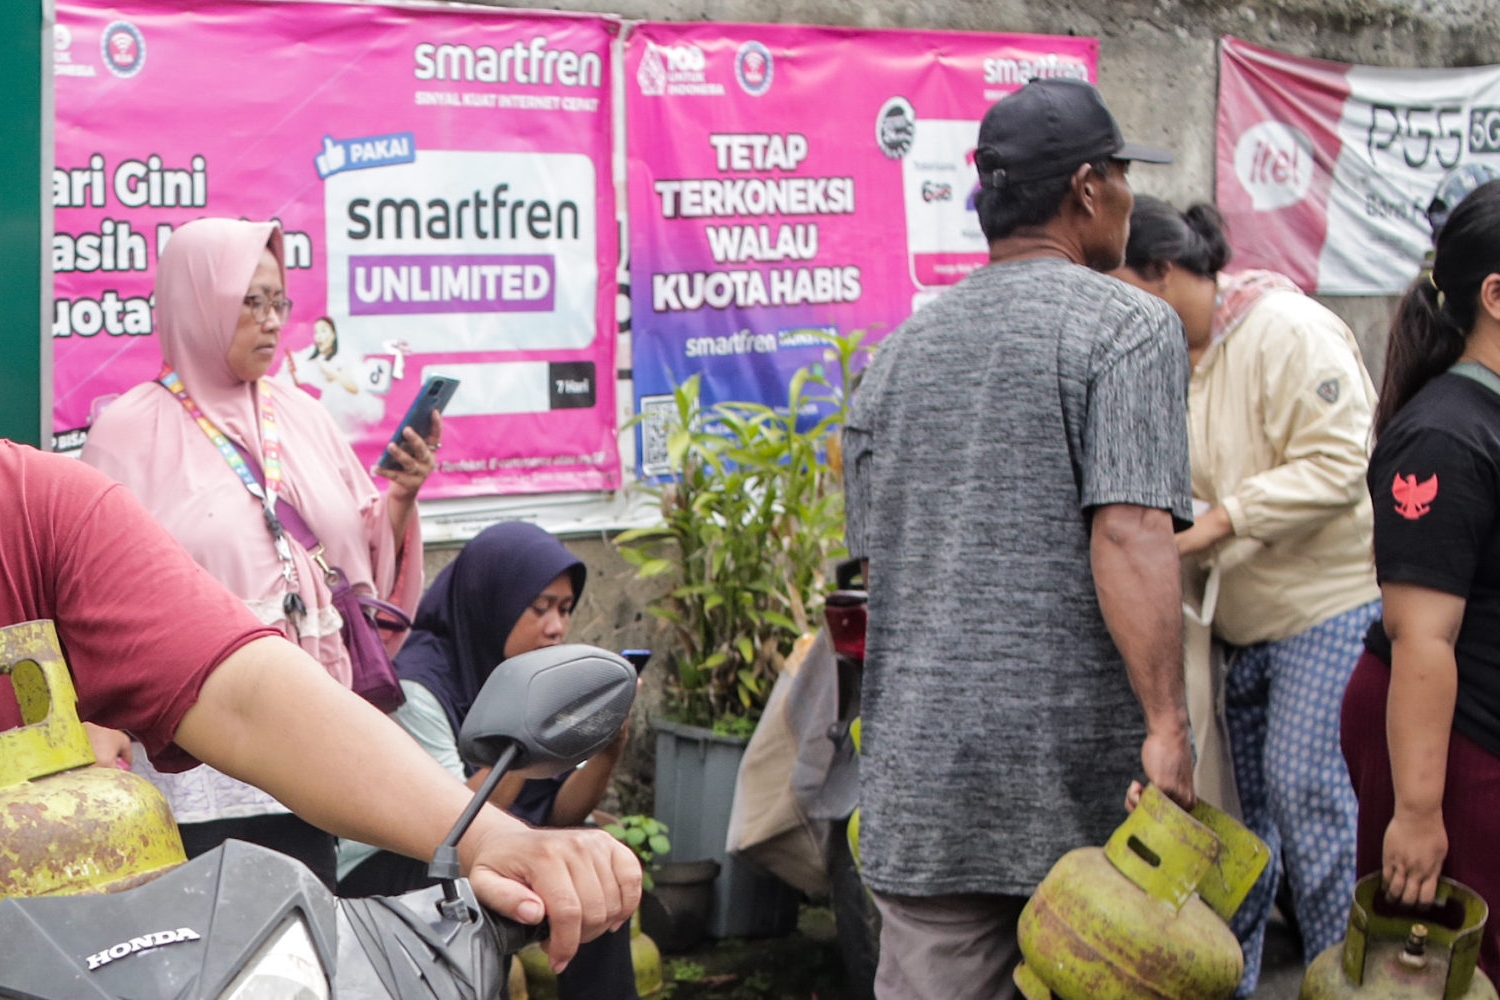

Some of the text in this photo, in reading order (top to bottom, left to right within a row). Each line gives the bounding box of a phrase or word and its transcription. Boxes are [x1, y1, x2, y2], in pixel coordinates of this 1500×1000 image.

[414, 36, 602, 88] smartfren
[350, 137, 411, 164] PAKAI
[709, 132, 809, 172] TETAP
[1250, 140, 1300, 186] itel
[53, 153, 208, 208] ari Gini
[654, 176, 856, 218] TERKONEKSI
[346, 183, 579, 241] smartfren
[53, 217, 148, 272] asih
[705, 223, 819, 264] WALAU
[354, 264, 551, 304] UNLIMITED
[652, 265, 862, 313] KUOTA HABIS
[53, 290, 156, 338] uota
[685, 329, 778, 358] smartfren
[85, 926, 201, 972] HONDA
